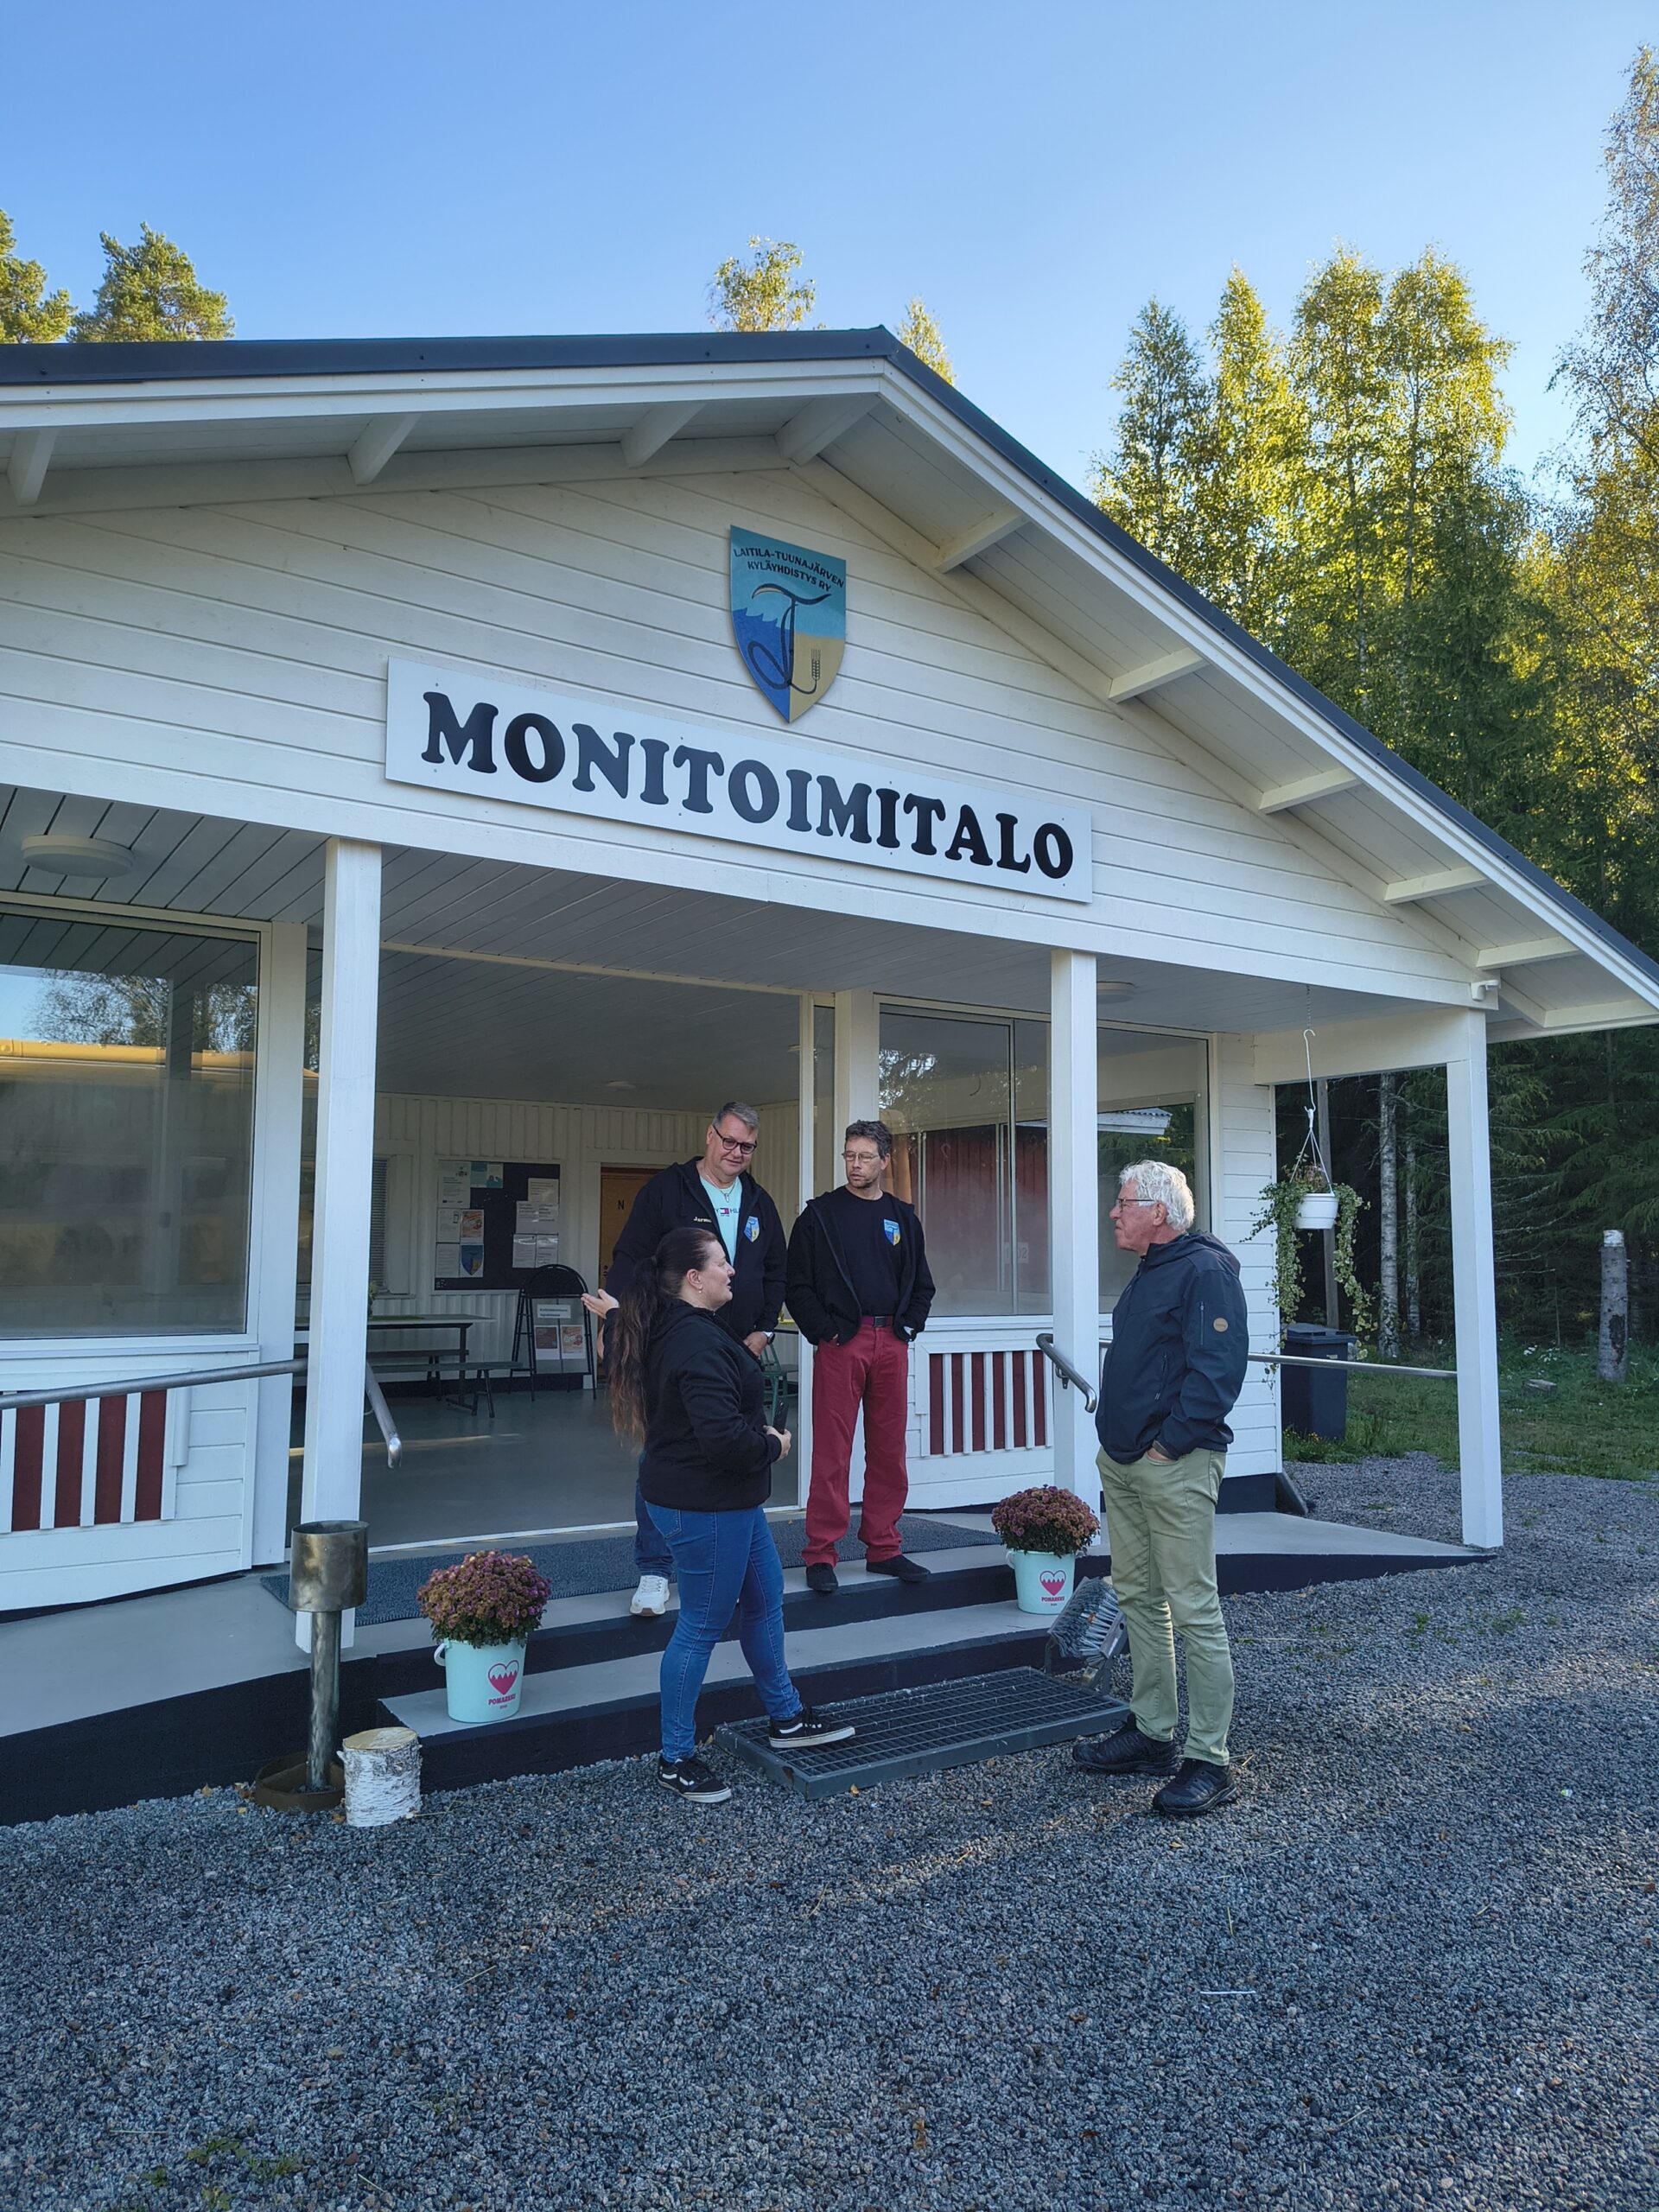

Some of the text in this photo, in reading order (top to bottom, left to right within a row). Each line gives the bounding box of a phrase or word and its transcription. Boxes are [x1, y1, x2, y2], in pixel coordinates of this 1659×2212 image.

[734, 548, 844, 588] LAITILA-TUUNAJÄRVEN
[747, 560, 831, 592] KYLÄYHDISTYS RY
[421, 691, 1074, 880] MONITOIMITALO
[618, 1199, 625, 1210] N
